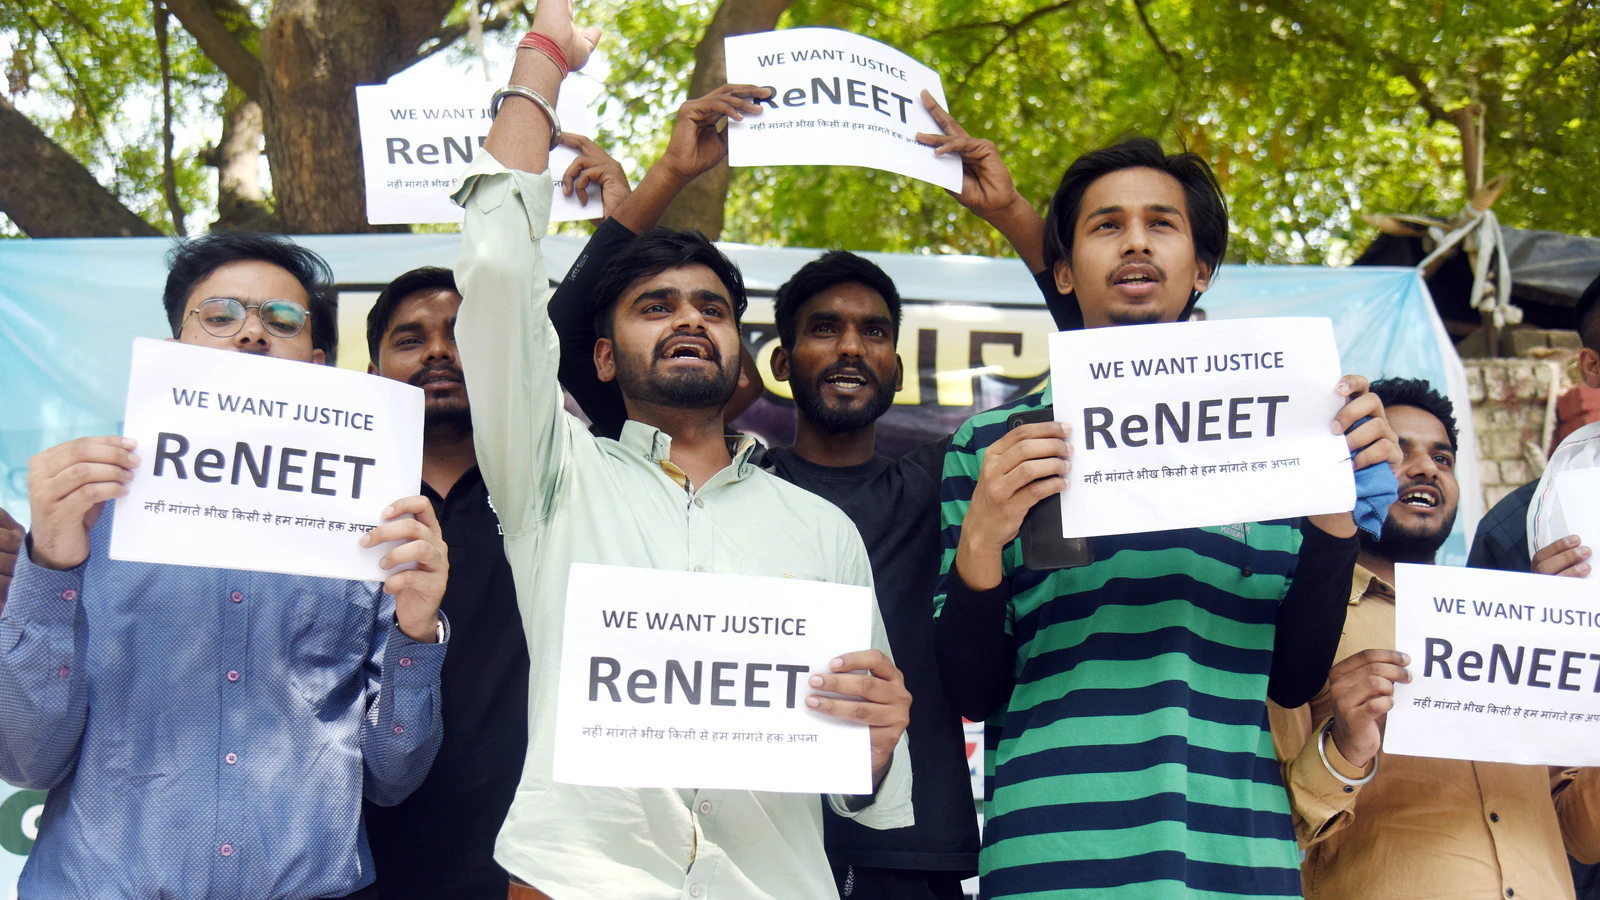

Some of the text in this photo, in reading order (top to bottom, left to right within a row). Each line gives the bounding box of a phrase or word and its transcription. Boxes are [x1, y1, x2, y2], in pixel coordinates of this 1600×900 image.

[758, 49, 907, 81] WE WANT JUSTICE
[390, 109, 417, 120] WE
[423, 109, 474, 119] WANT
[386, 136, 487, 164] ReN
[1089, 352, 1284, 379] WE WANT JUSTICE
[173, 387, 374, 431] WE WANT JUSTICE
[1083, 395, 1289, 450] ReNEET
[153, 432, 376, 499] ReNEET
[602, 609, 806, 636] WE WANT JUSTICE
[1433, 597, 1600, 628] WE WANT JUSTIC
[589, 656, 810, 709] ReNEET
